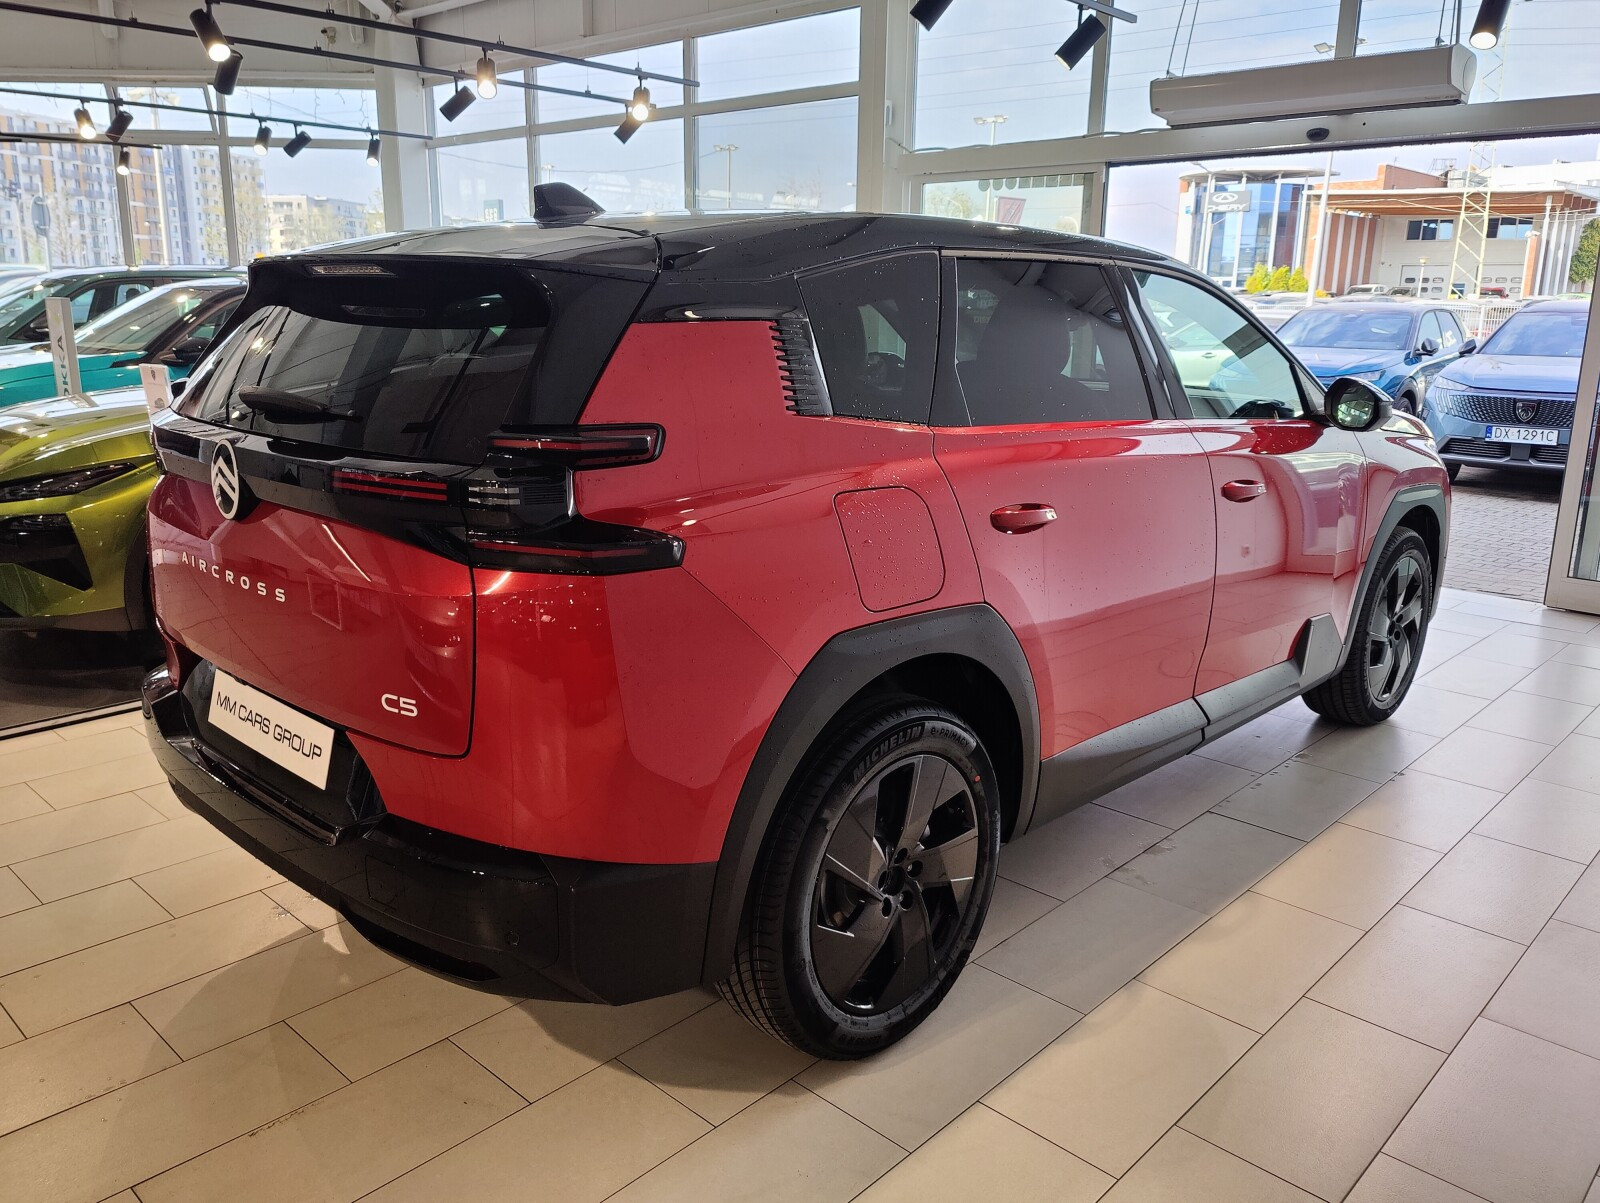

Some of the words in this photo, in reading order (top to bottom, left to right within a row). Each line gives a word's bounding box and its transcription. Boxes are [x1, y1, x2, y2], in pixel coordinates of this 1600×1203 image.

[1206, 202, 1250, 213] CHERY
[1494, 427, 1511, 440] DX
[1516, 428, 1555, 442] 1291C
[181, 551, 287, 603] AIRCROSS
[380, 693, 419, 718] C5
[216, 690, 237, 717] MM
[237, 704, 271, 736] CARS
[272, 724, 323, 761] GROUP
[853, 726, 923, 782] MICHELIN
